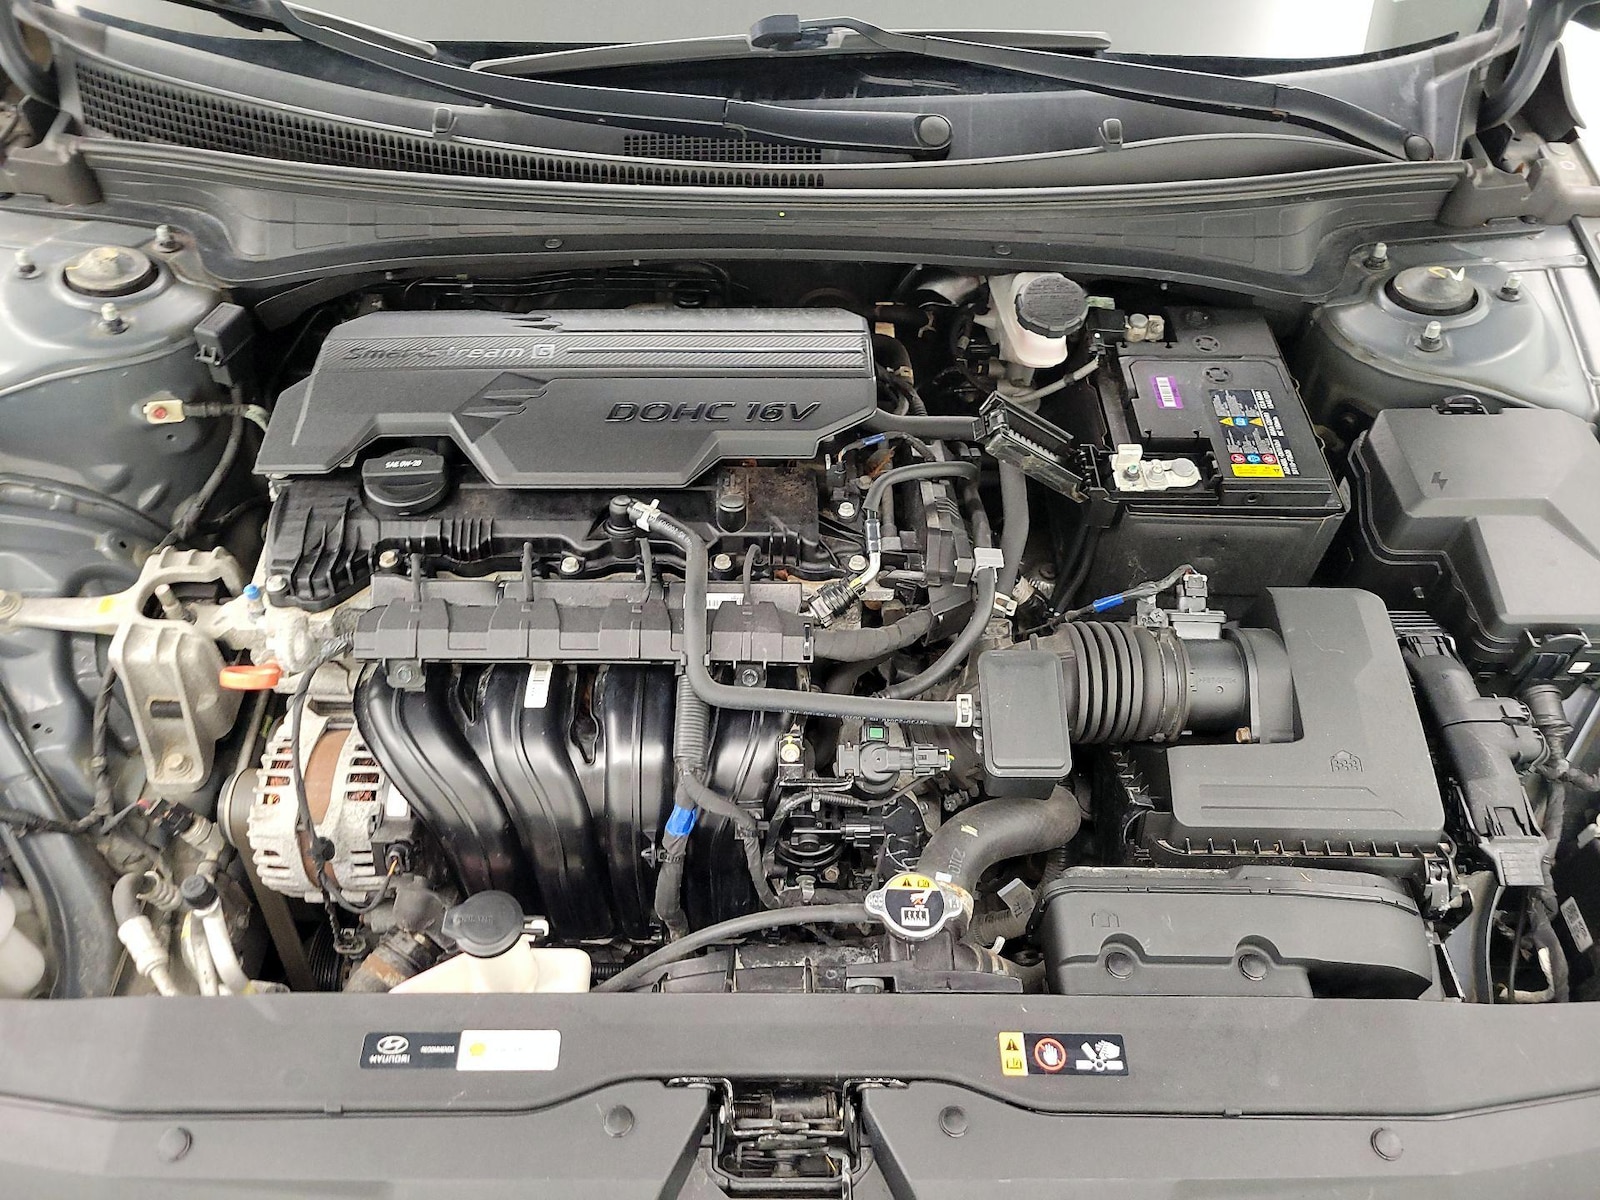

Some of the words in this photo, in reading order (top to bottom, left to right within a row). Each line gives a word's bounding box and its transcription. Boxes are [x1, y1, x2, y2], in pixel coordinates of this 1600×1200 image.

[343, 345, 525, 361] Smartstream
[605, 401, 736, 423] DOHC
[745, 401, 822, 423] 16V
[369, 1054, 411, 1064] HYUNDAI
